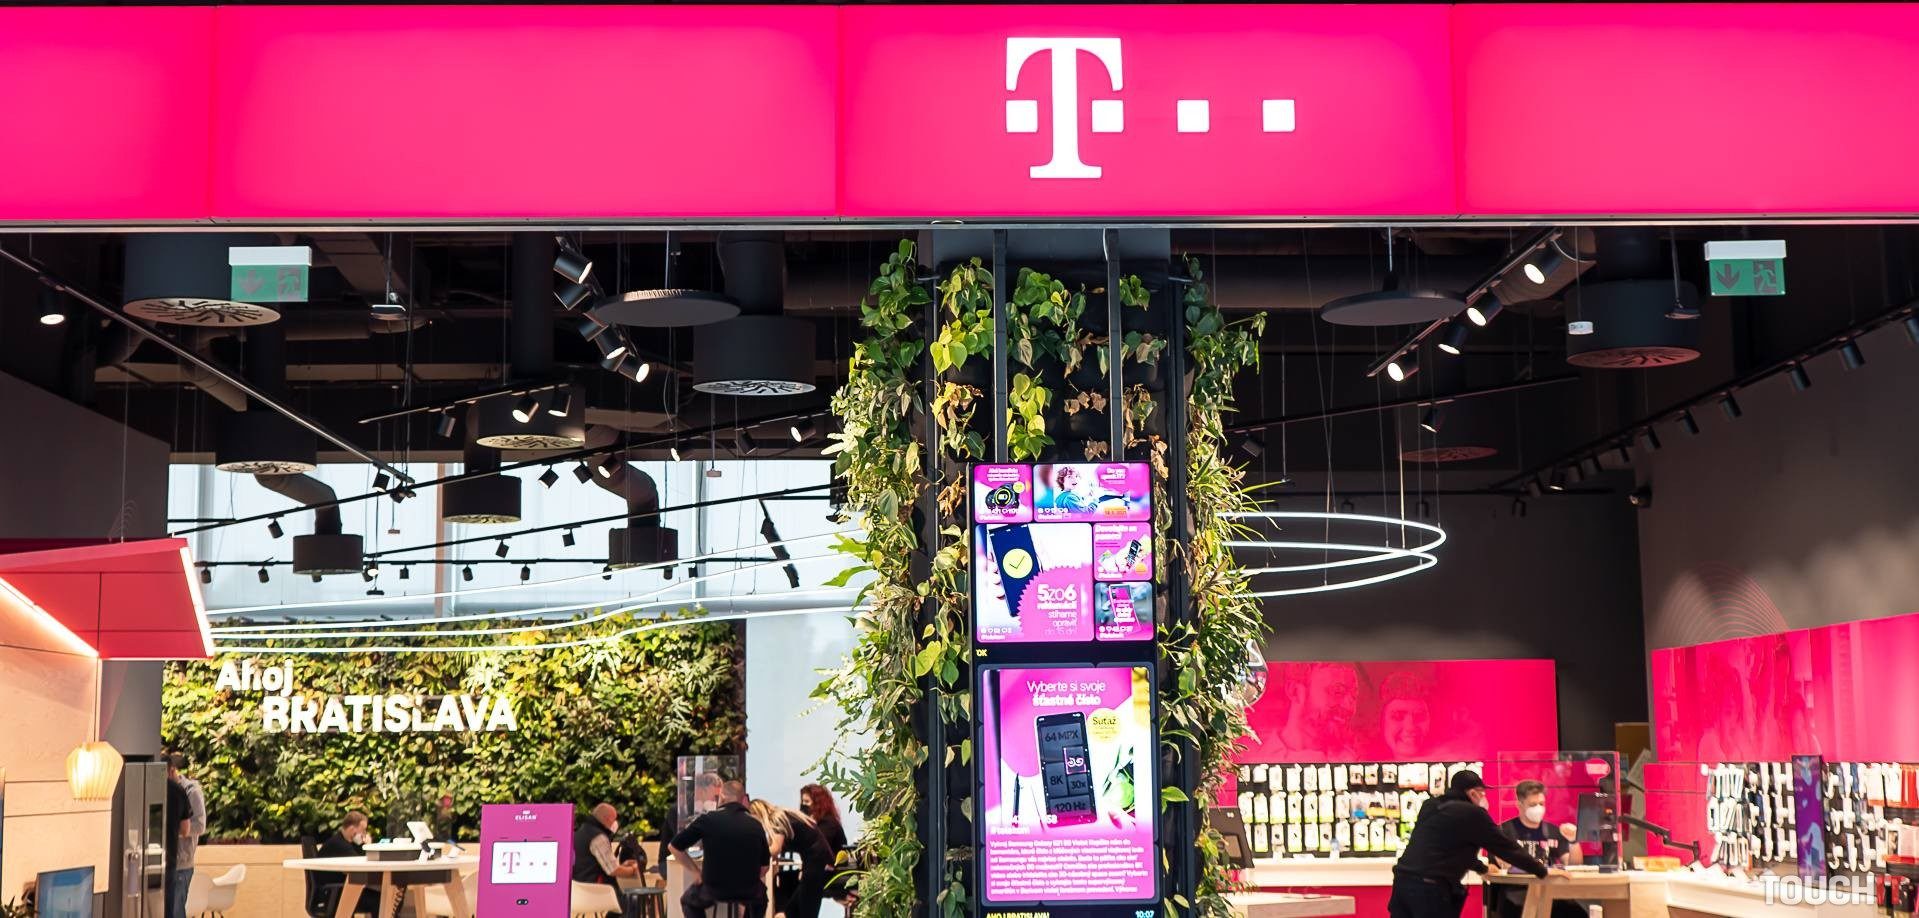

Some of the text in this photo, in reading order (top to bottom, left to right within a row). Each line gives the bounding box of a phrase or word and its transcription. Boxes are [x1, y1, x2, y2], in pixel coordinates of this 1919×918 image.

[215, 659, 294, 696] Ahoj
[1026, 681, 1106, 693] Vyberte si svoje
[262, 694, 518, 733] BRATISLAVA
[1055, 803, 1072, 813] 120
